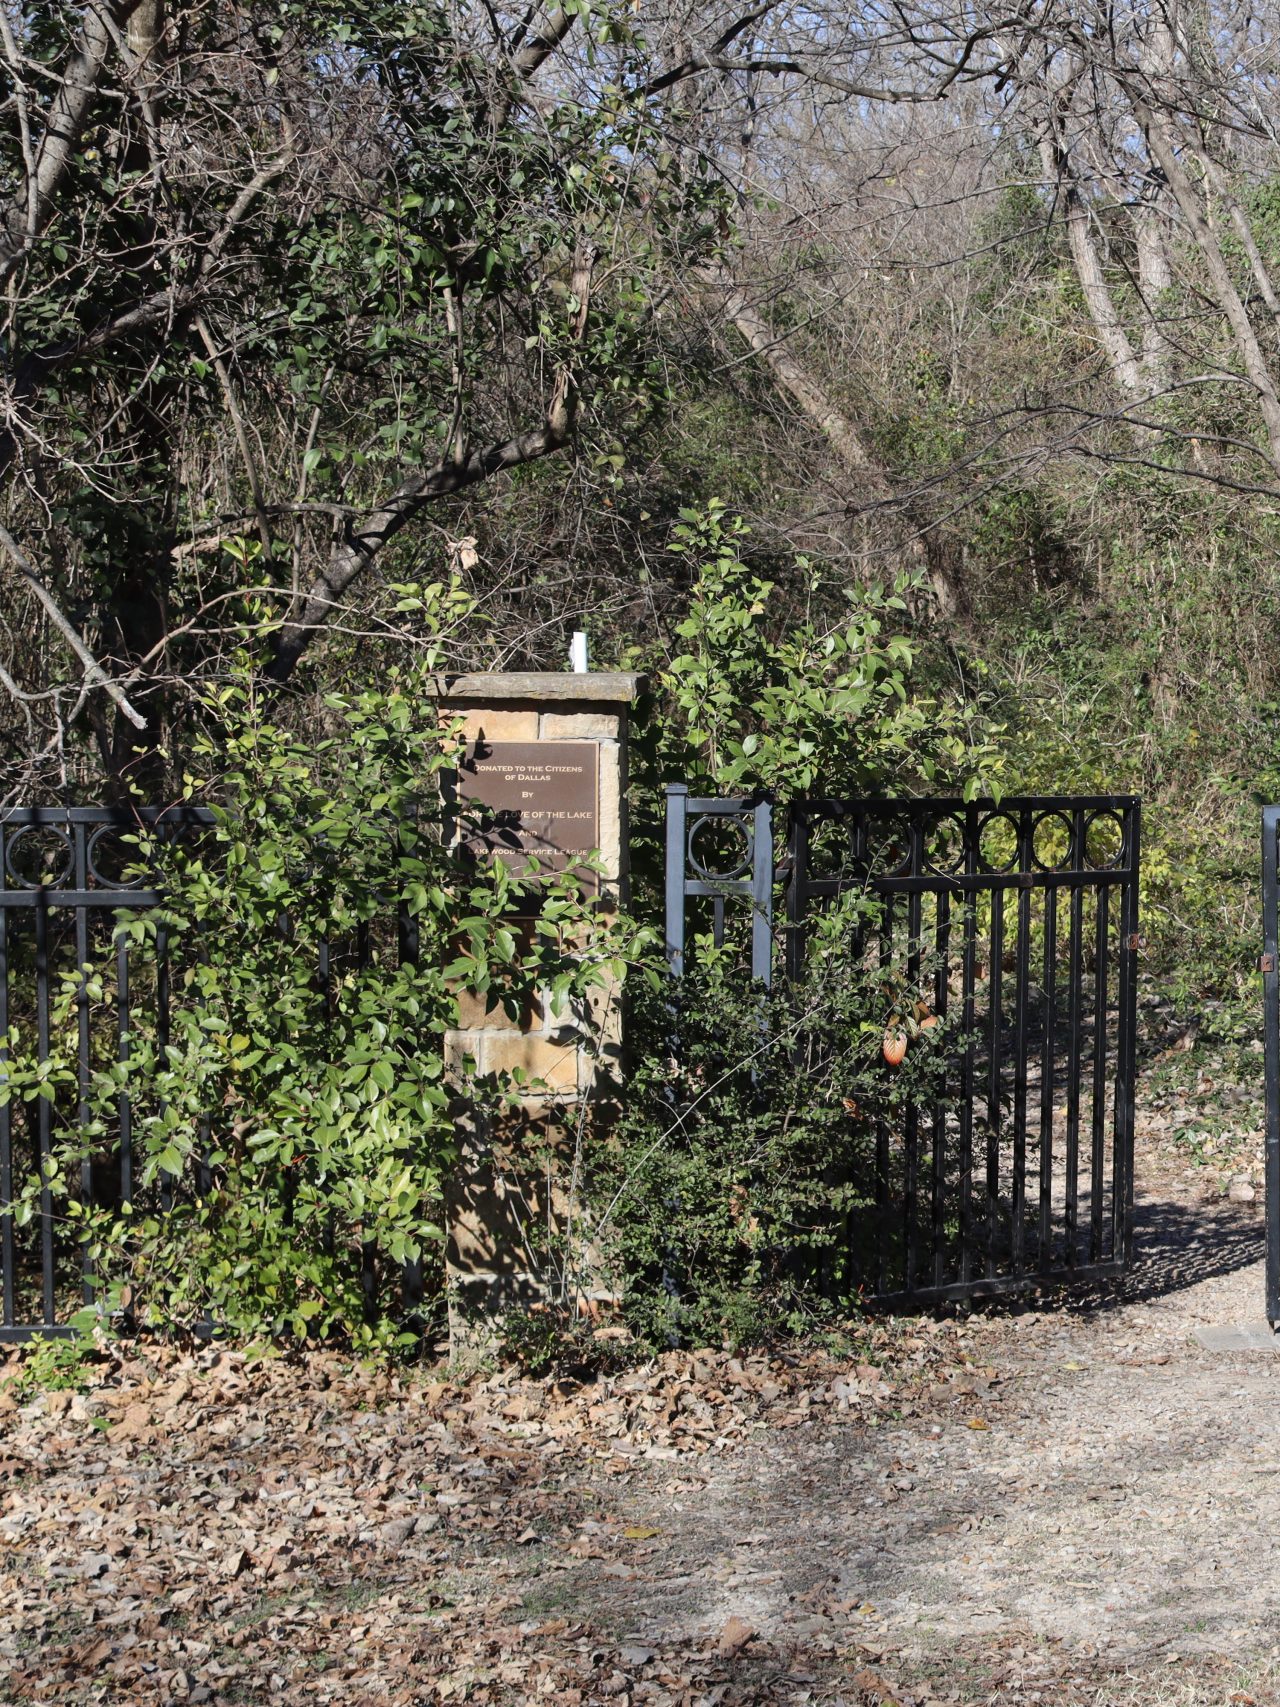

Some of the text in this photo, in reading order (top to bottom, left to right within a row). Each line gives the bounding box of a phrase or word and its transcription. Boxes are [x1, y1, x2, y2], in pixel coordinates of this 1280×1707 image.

[531, 811, 543, 819] OF
[546, 811, 565, 819] THE
[567, 811, 593, 819] LAKE
